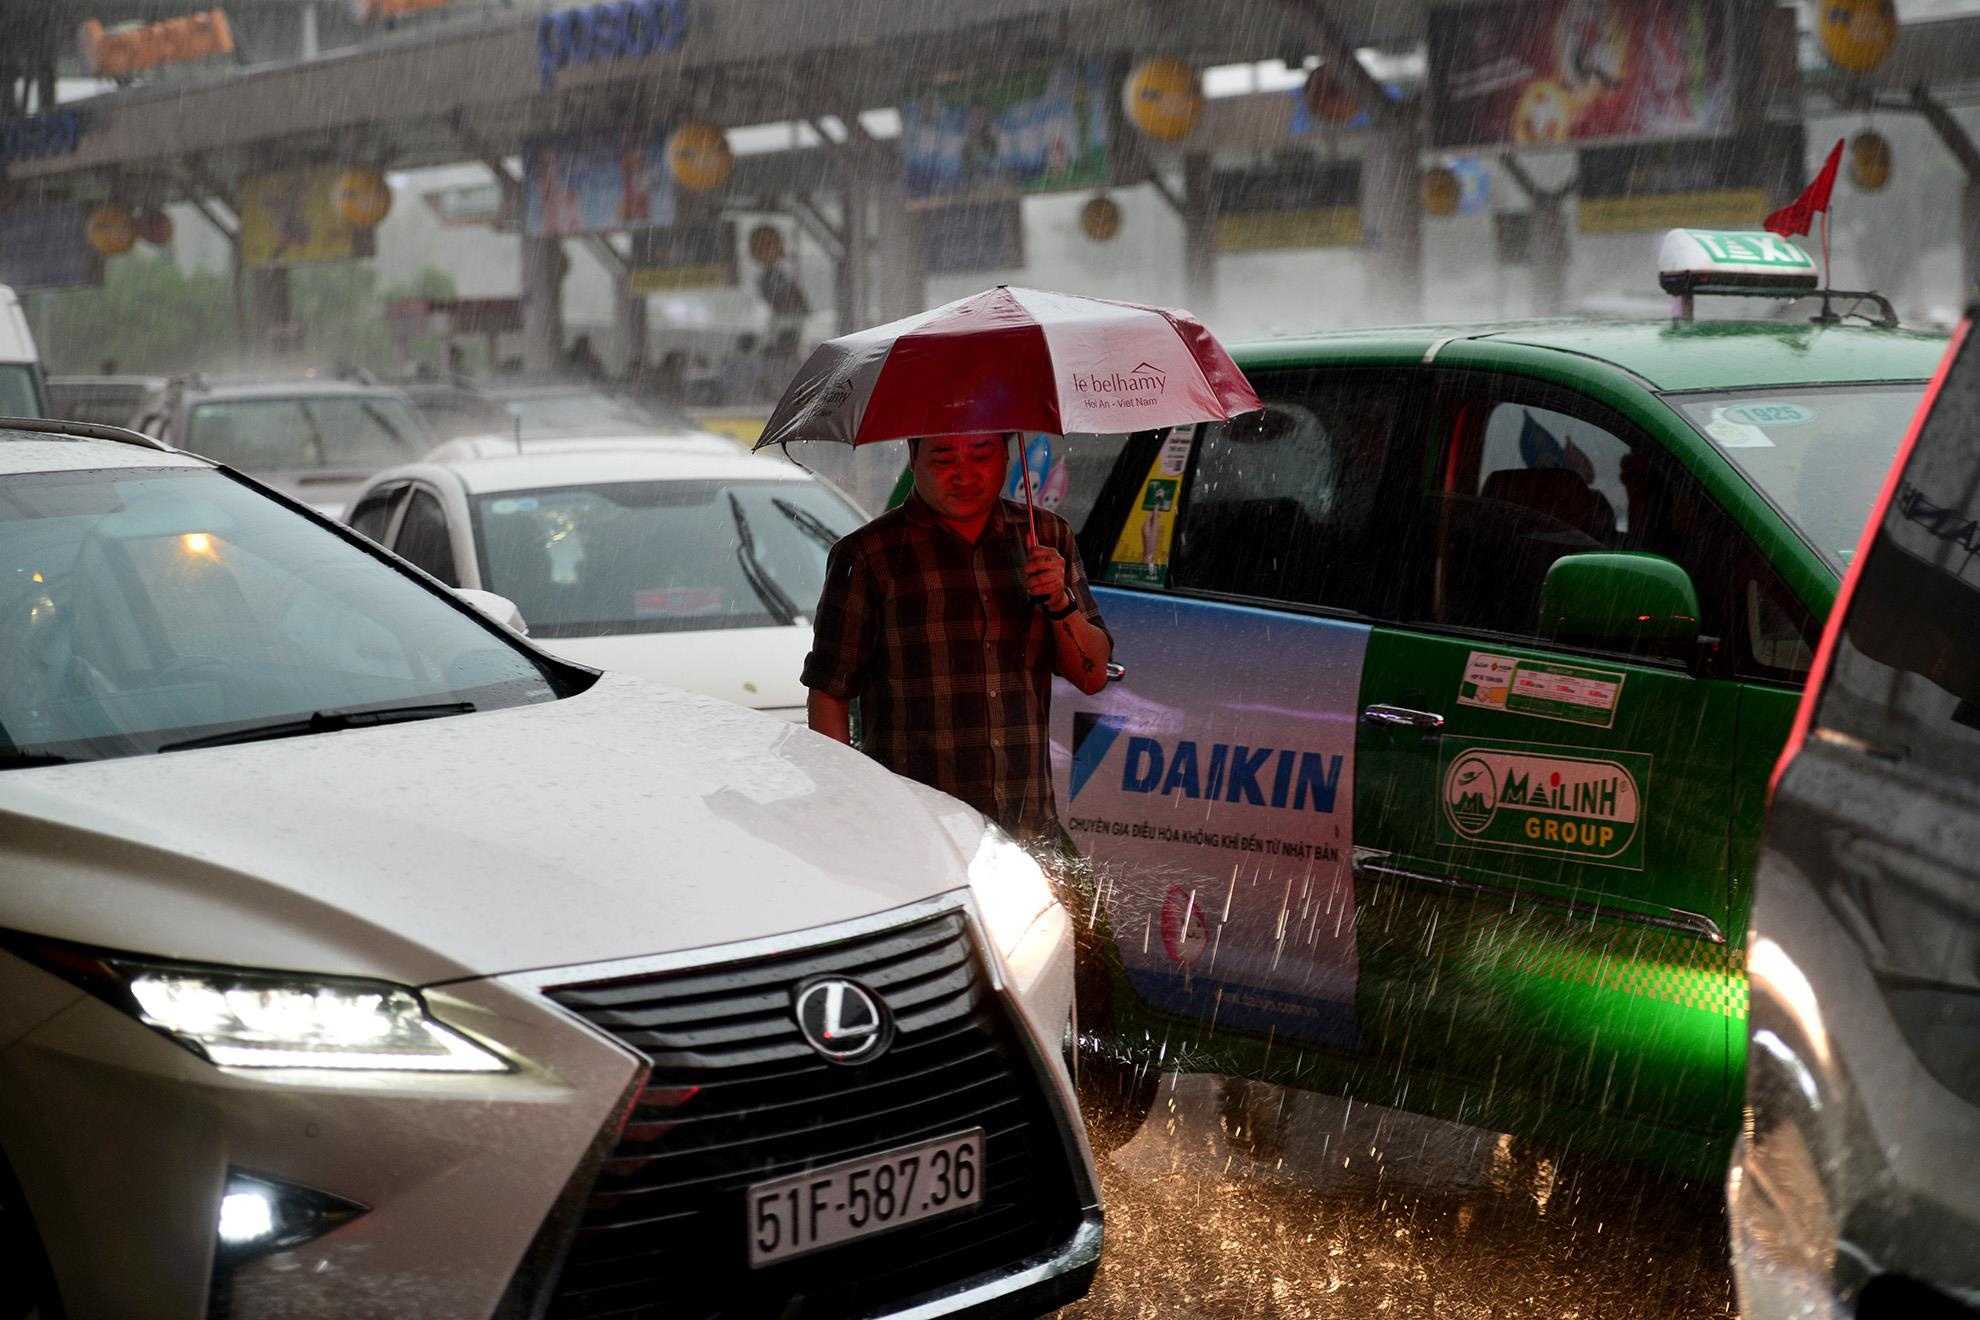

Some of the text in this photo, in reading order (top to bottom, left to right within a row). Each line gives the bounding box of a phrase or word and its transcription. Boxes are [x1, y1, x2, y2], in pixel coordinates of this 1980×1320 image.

[1072, 373, 1166, 394] le belhamy
[1099, 399, 1109, 408] An
[1117, 398, 1134, 408] Viet
[1136, 397, 1158, 407] Nam
[1736, 406, 1803, 422] 1925
[1121, 736, 1344, 813] DAIKIN
[1069, 817, 1110, 834] CHUYÊN
[1112, 822, 1129, 836] GIA
[1524, 816, 1615, 848] GROUP
[757, 1143, 974, 1252] 51F-587.36
